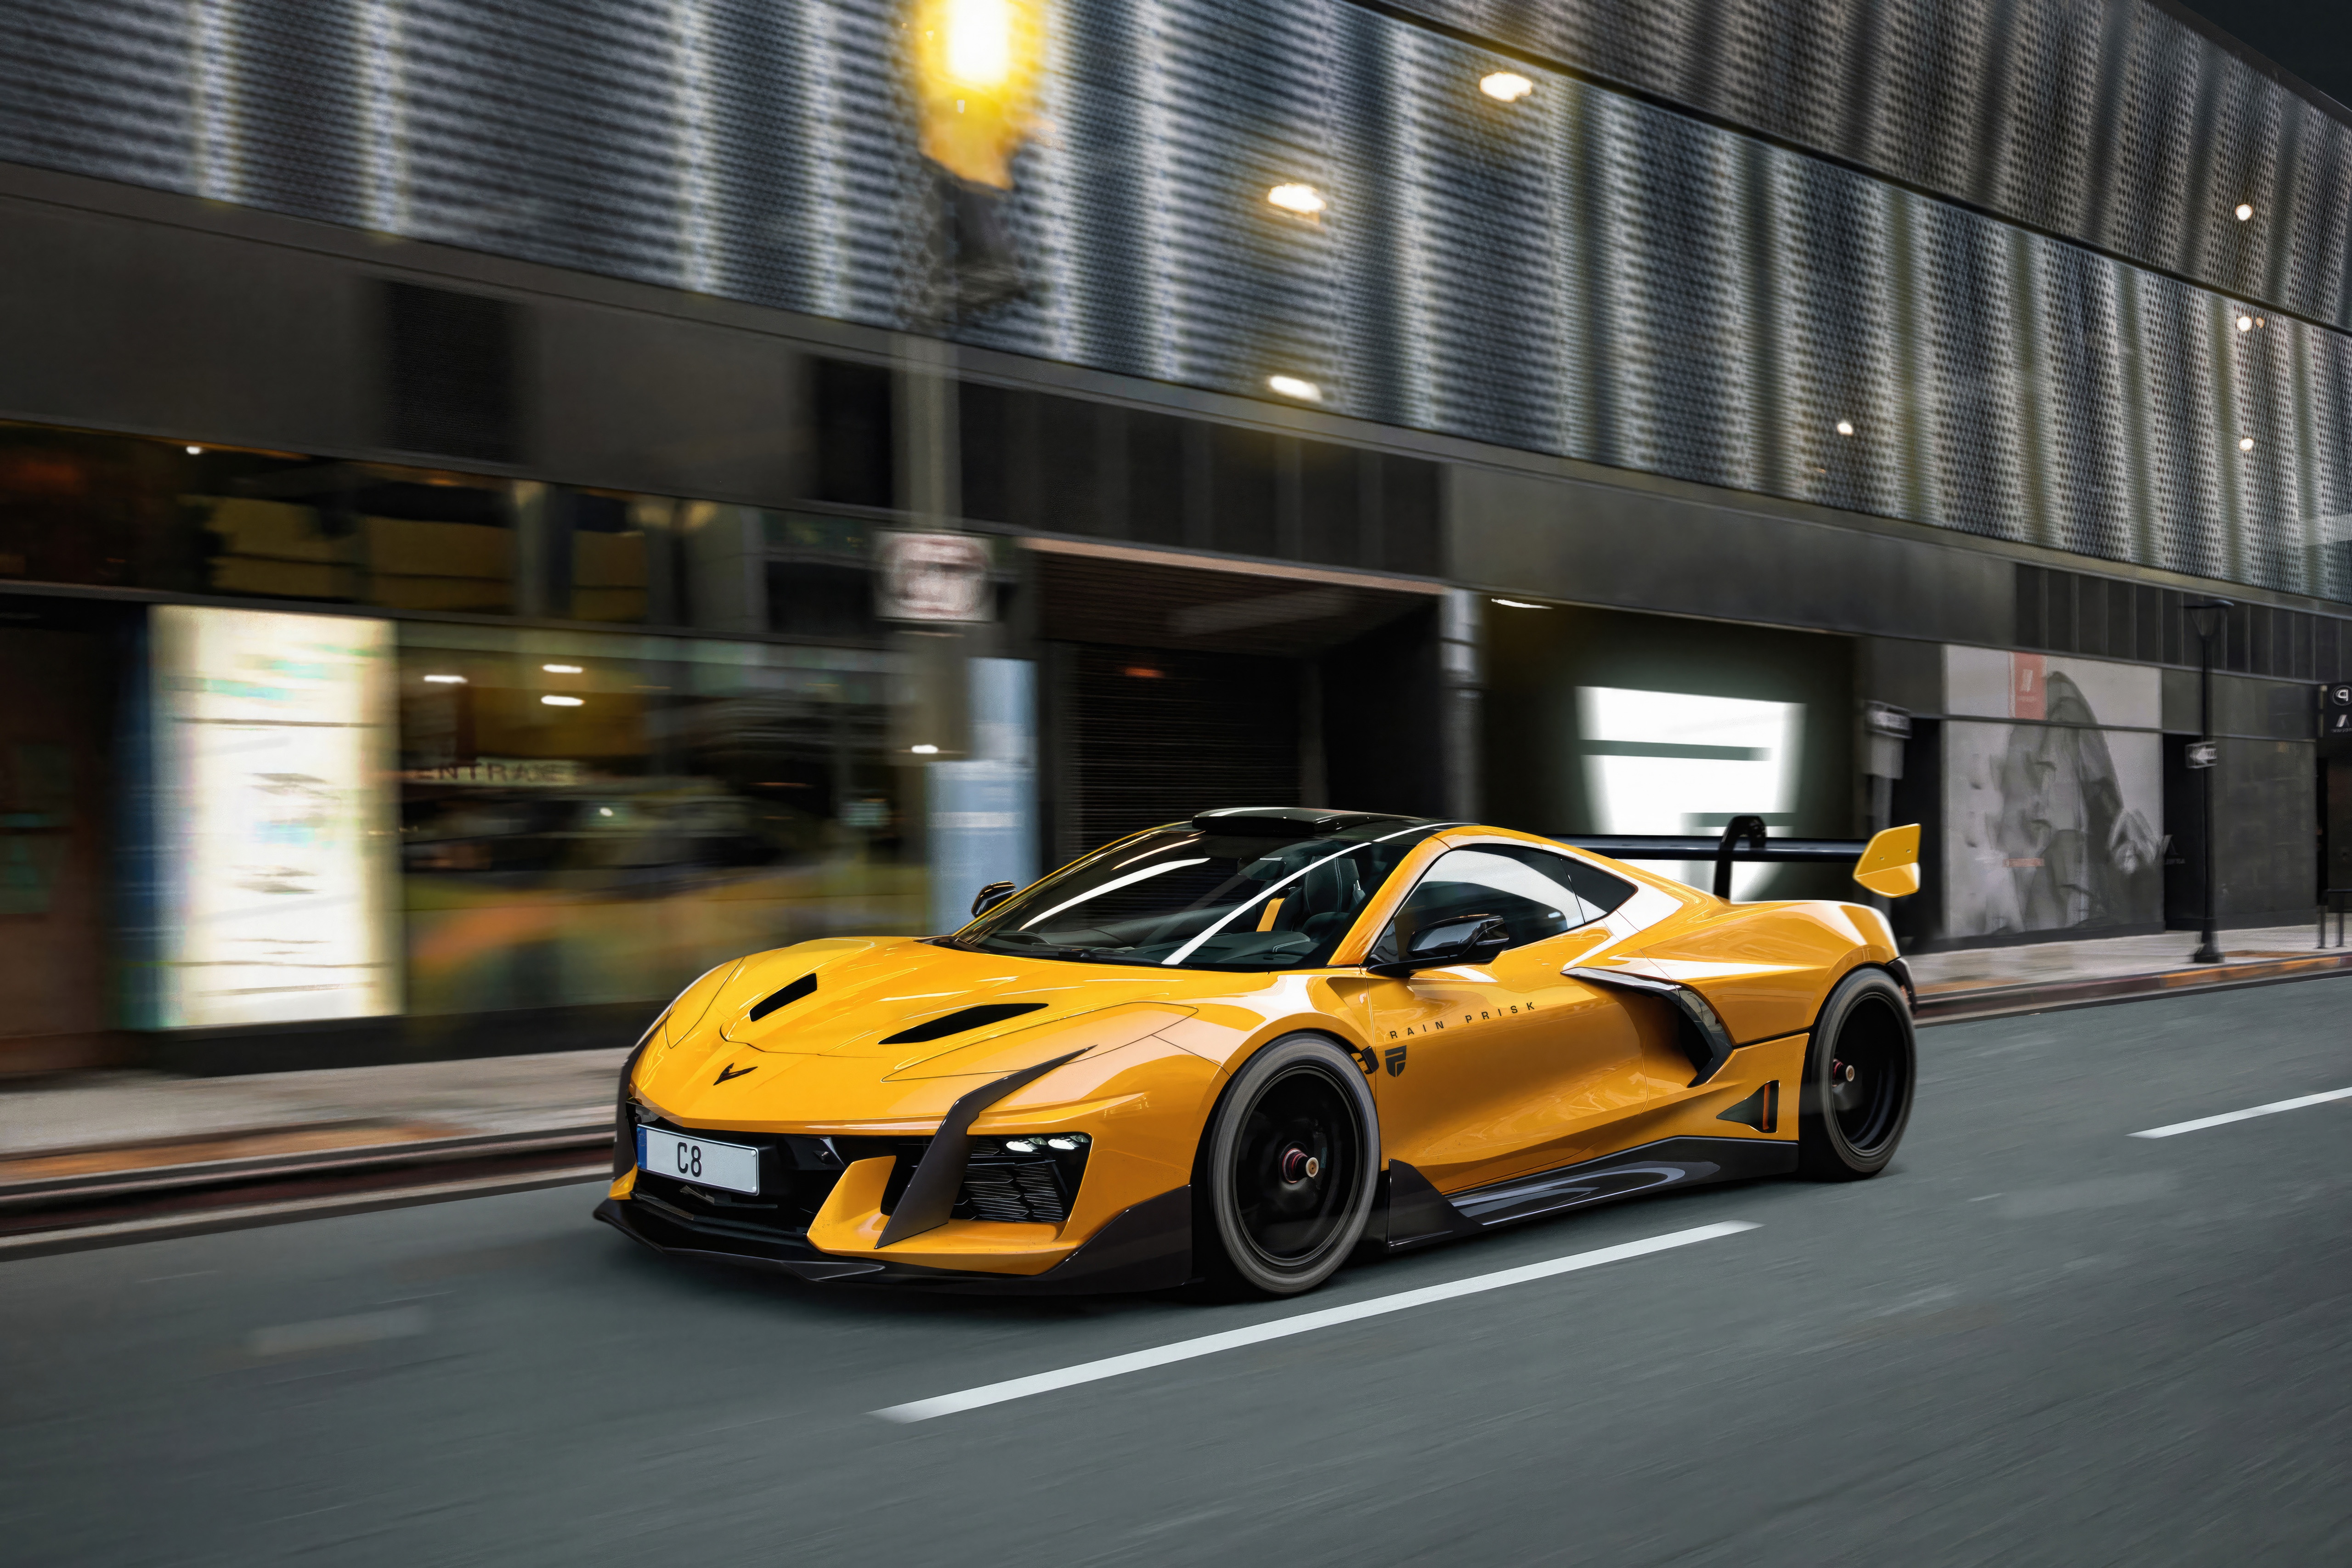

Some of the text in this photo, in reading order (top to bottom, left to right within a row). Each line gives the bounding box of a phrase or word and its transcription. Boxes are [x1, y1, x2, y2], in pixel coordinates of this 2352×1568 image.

[1390, 1002, 1535, 1039] RAIN PRISK
[677, 1142, 702, 1177] C8
